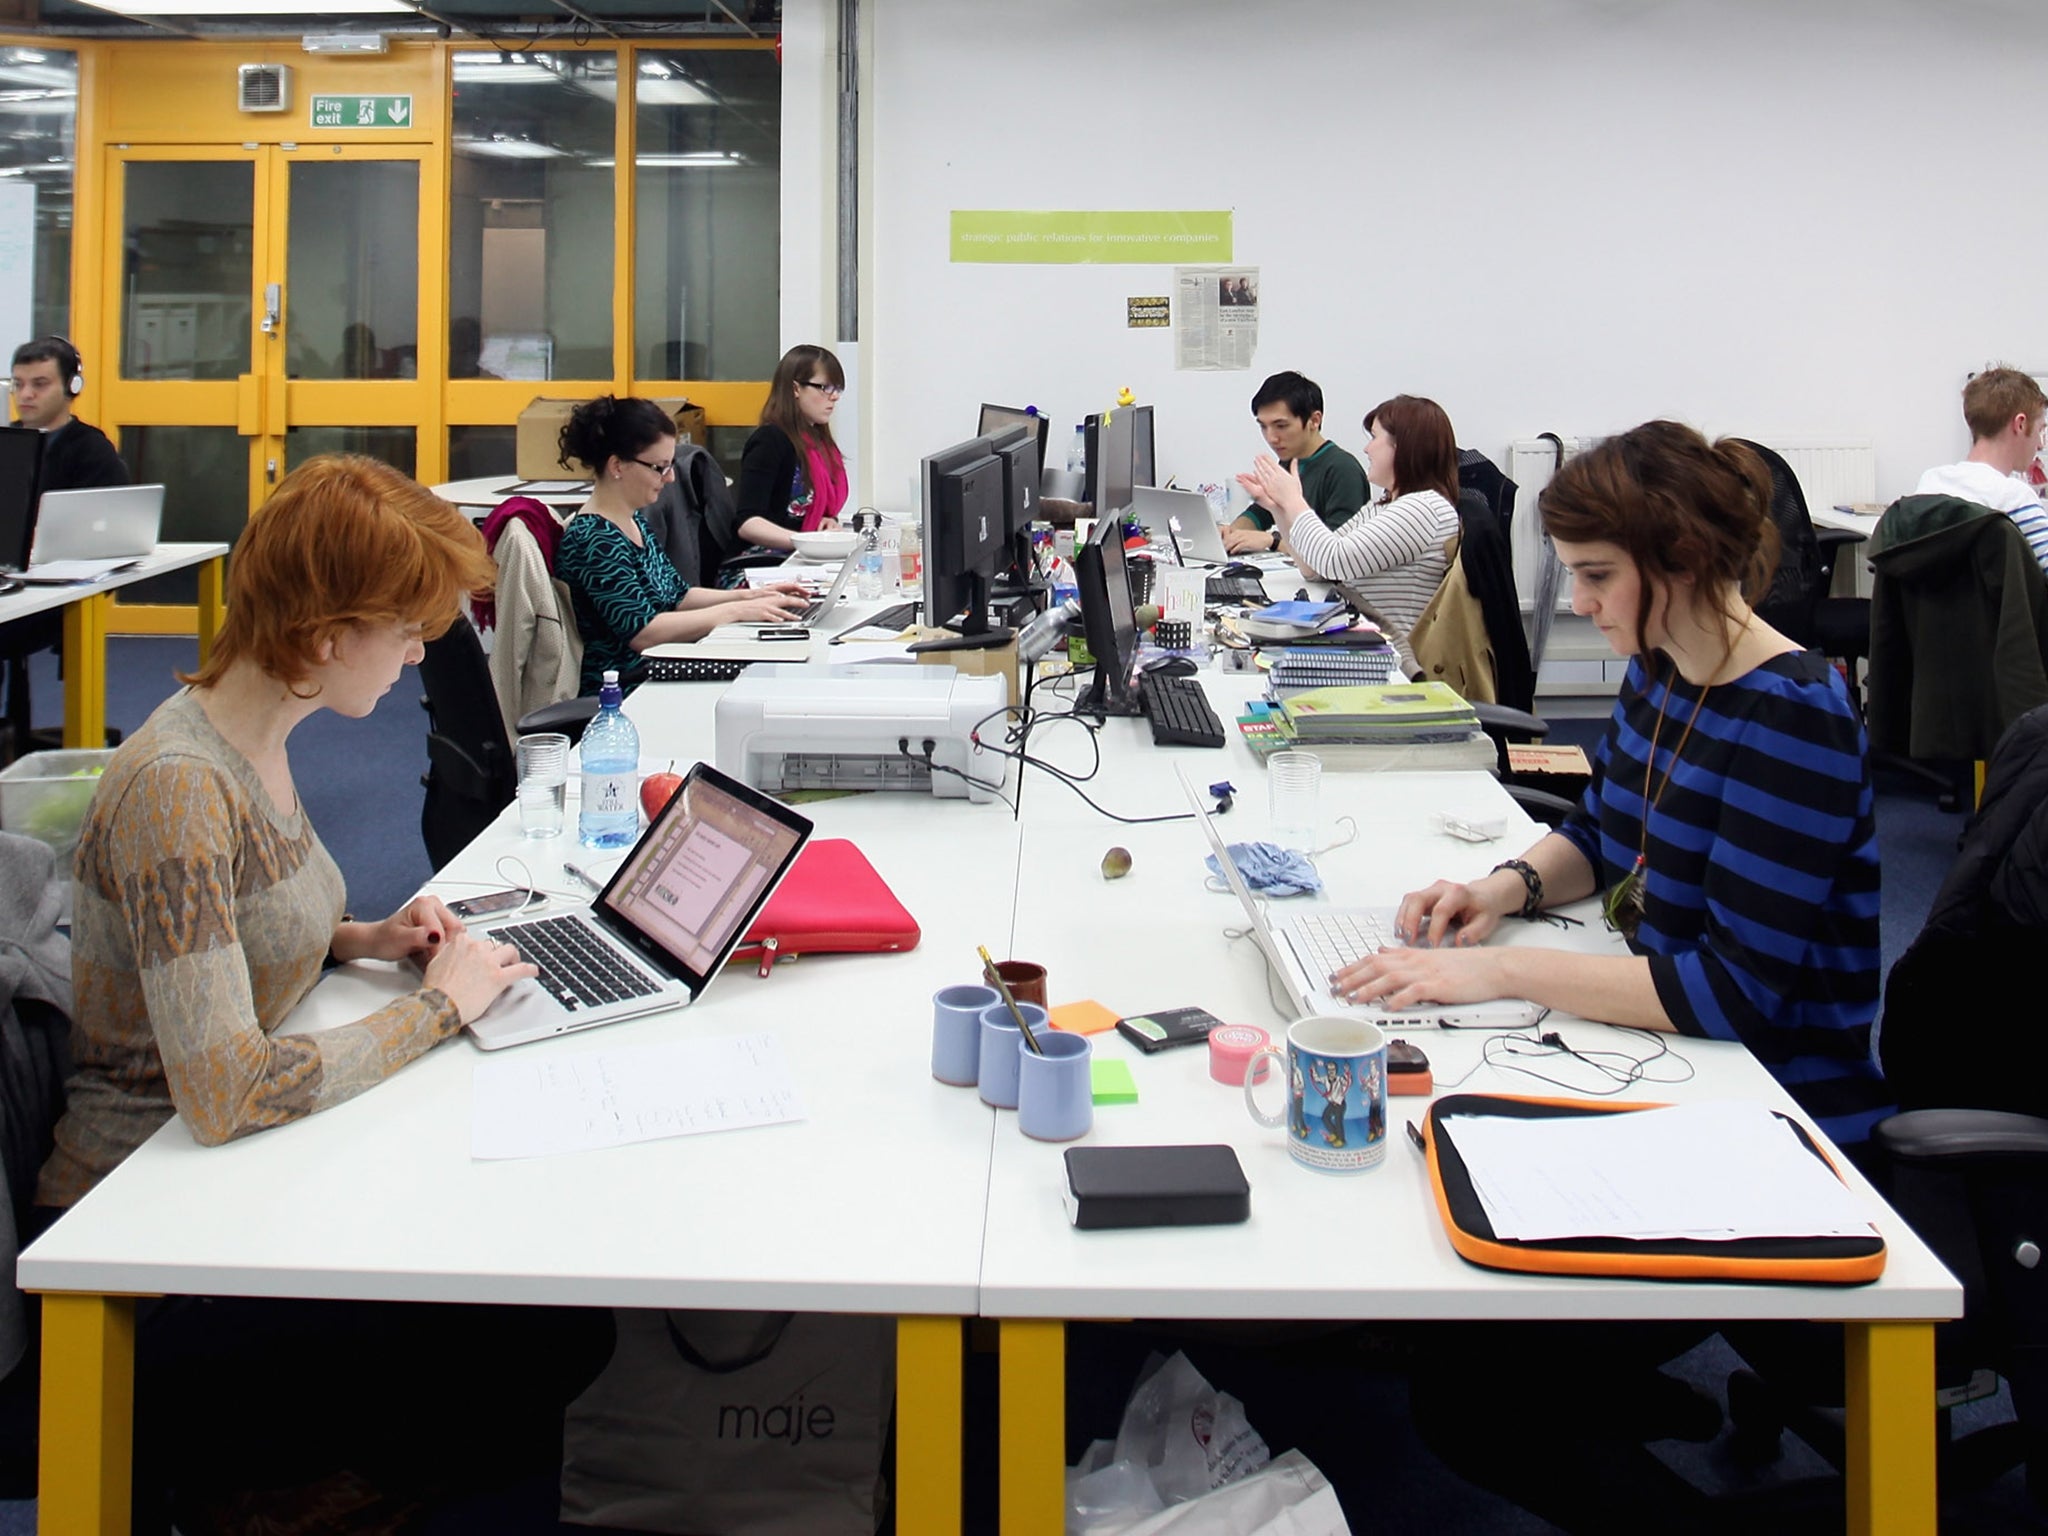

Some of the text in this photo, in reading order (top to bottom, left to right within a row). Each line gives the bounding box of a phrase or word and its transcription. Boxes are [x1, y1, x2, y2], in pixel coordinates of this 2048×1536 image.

[316, 100, 342, 112] Fire
[316, 112, 341, 124] exit
[960, 232, 1219, 245] strategic public relations for innovative companies
[718, 1395, 835, 1446] maje
